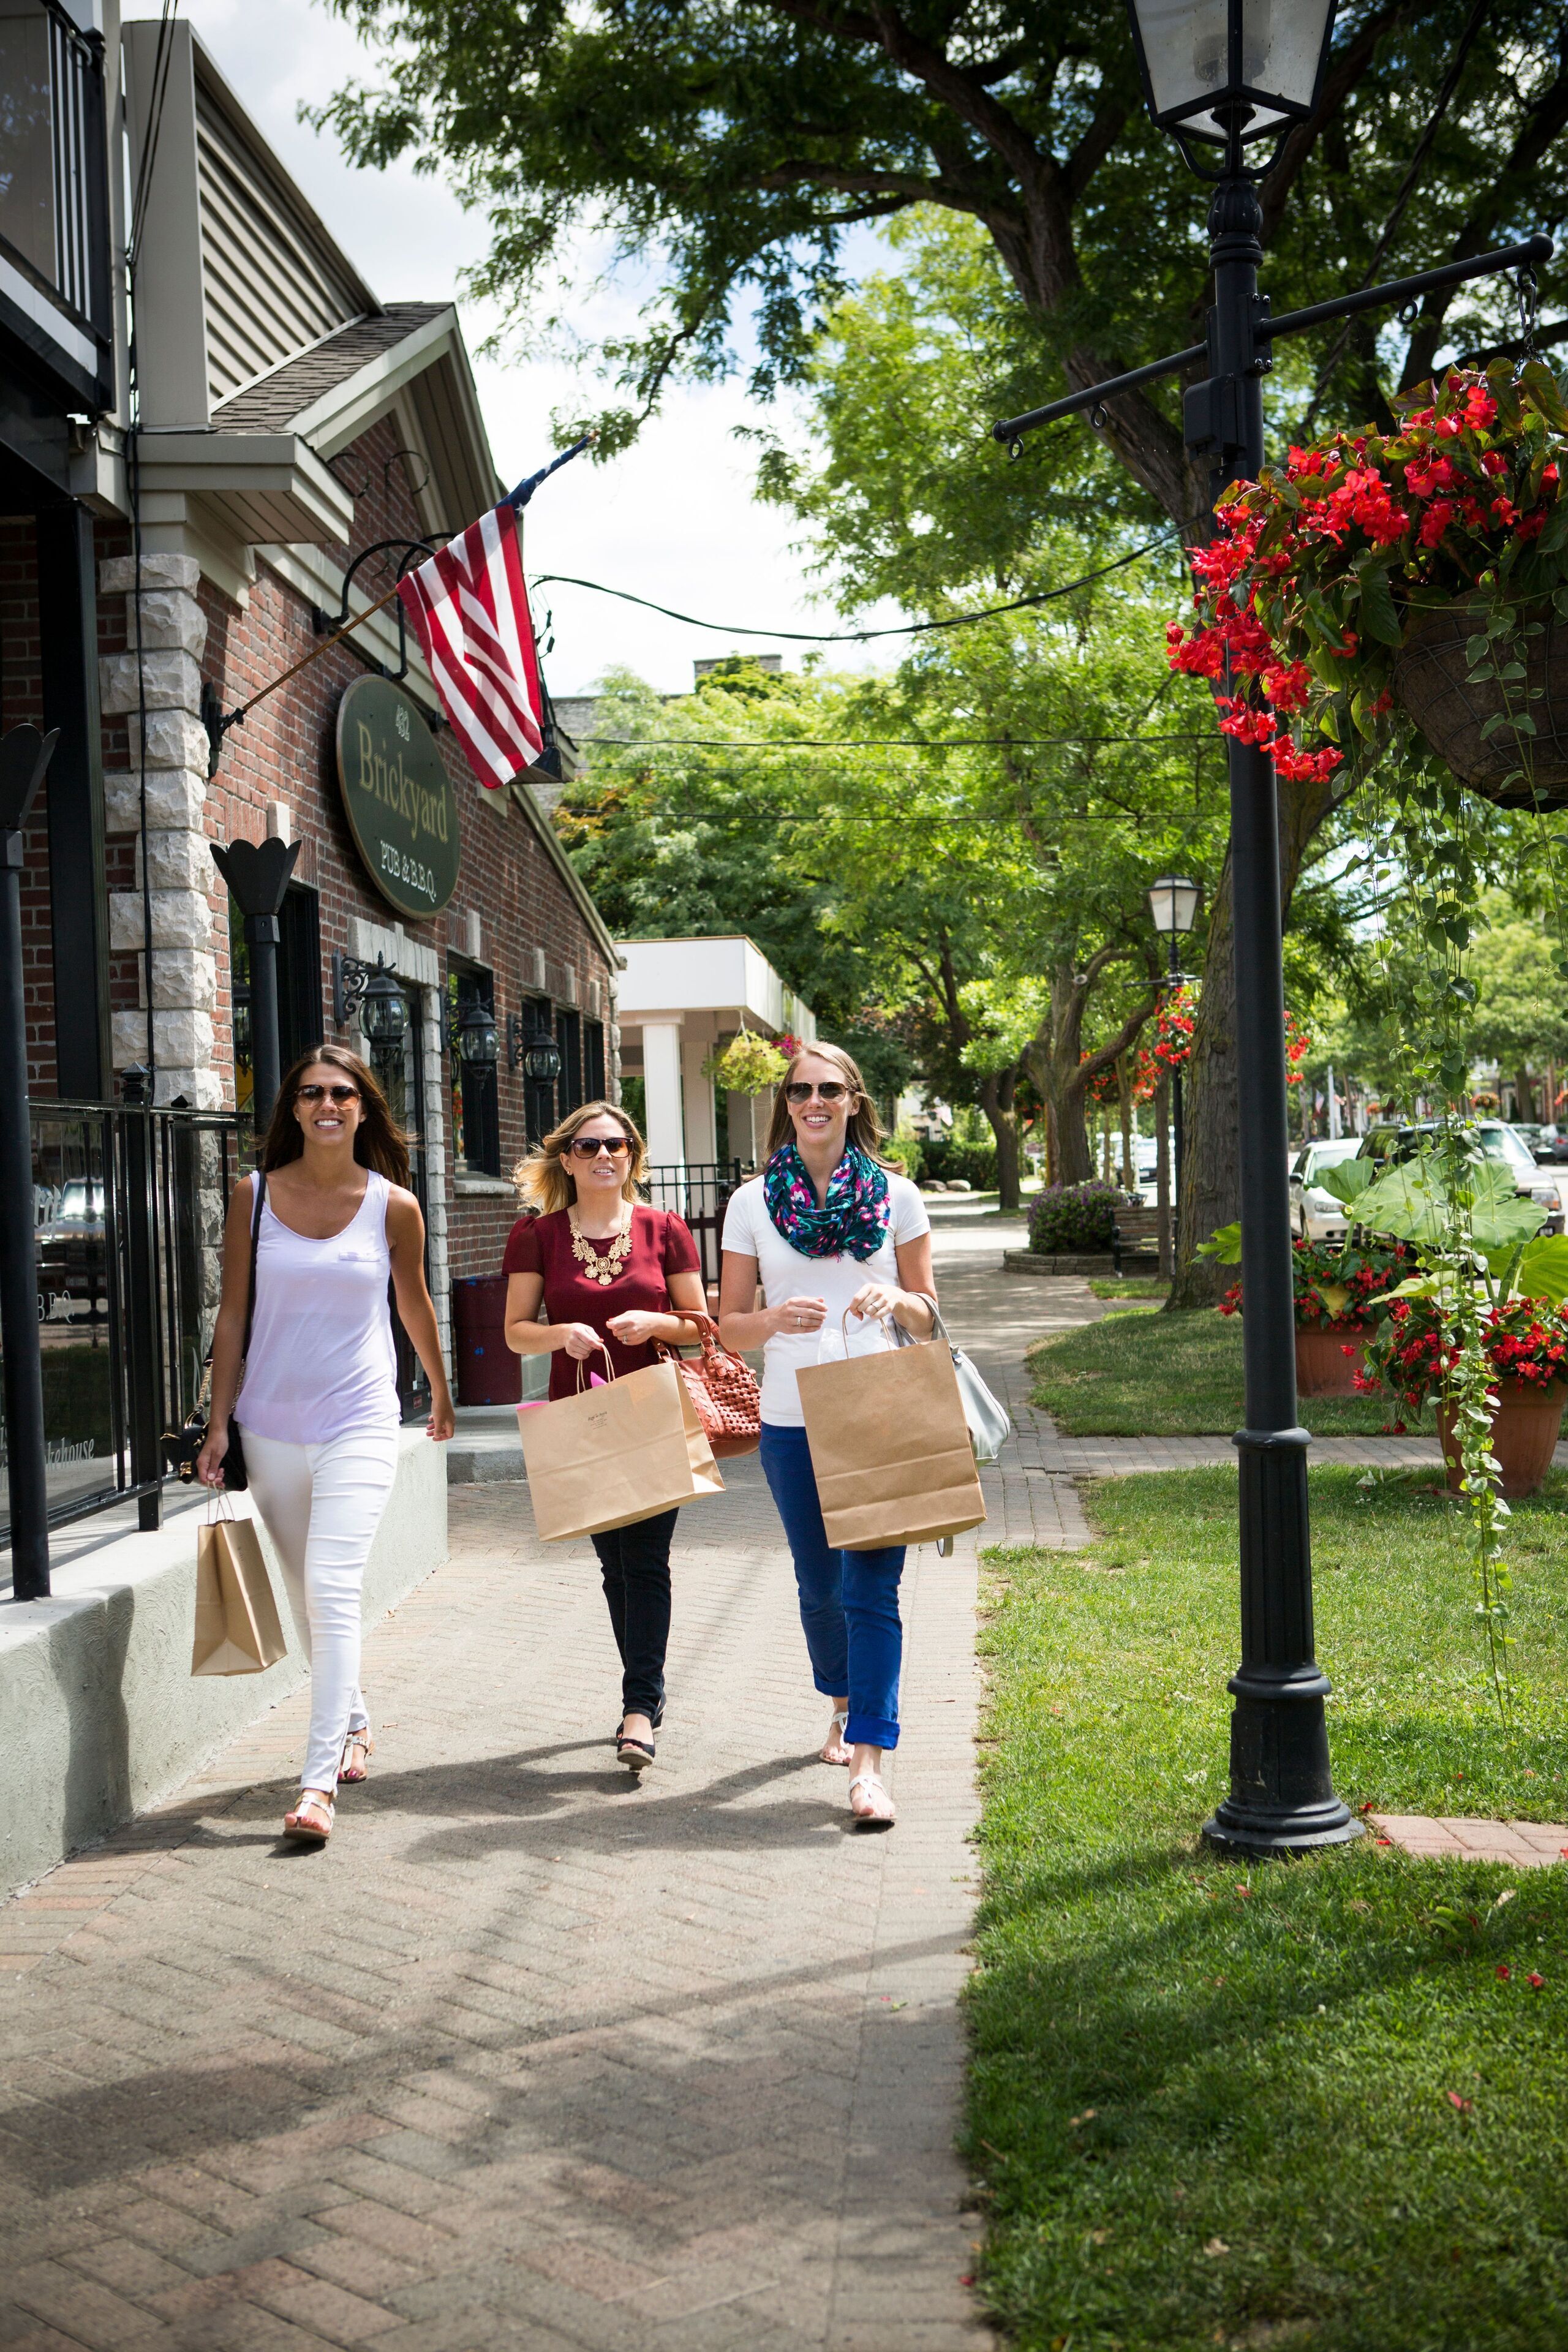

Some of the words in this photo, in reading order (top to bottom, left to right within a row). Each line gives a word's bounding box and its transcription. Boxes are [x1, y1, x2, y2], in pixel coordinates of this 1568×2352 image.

[358, 720, 448, 843] Brickyard
[380, 840, 400, 877] PUB
[402, 854, 410, 883] &
[44, 1437, 94, 1469] kehouse
